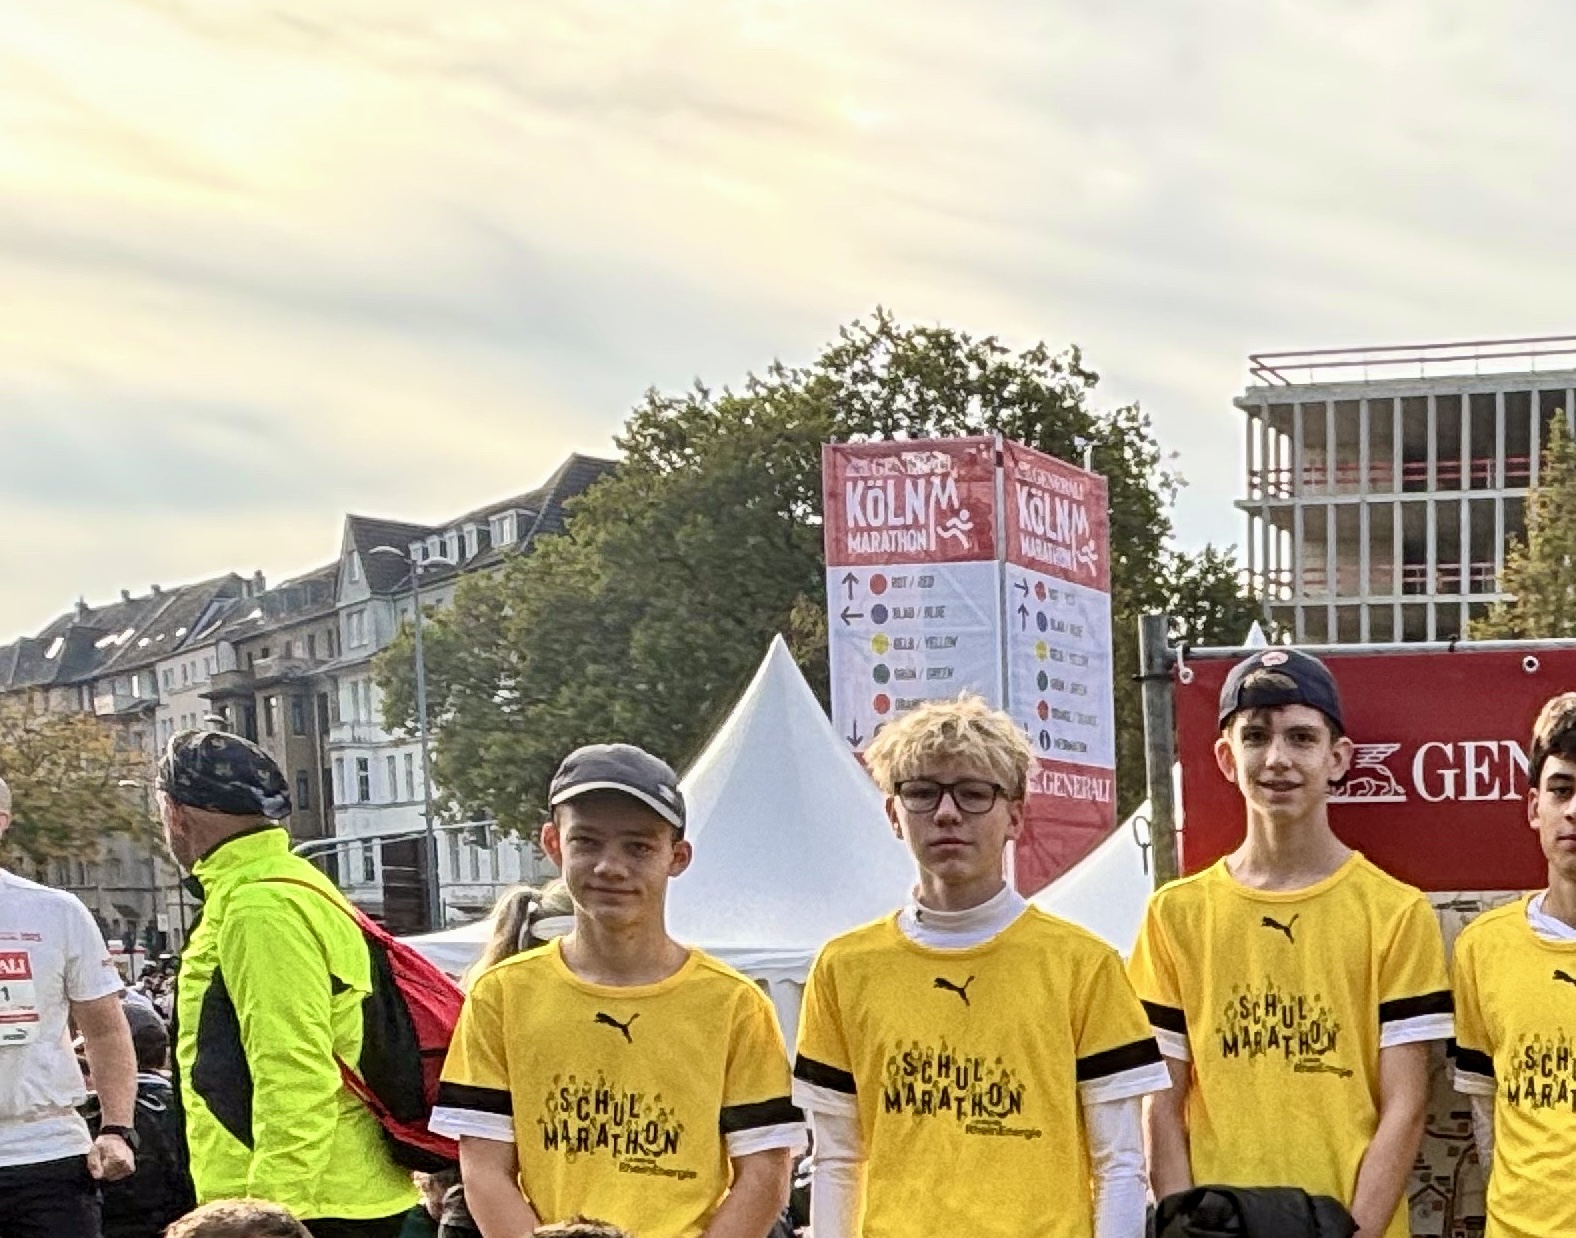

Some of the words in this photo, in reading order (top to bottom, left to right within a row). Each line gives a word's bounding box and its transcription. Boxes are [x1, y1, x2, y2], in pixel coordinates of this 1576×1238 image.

[846, 478, 926, 528] KÖLN
[1015, 482, 1071, 545] KÖLN
[848, 528, 927, 554] MARATHON
[1043, 771, 1111, 803] GENERALI
[1239, 994, 1307, 1029] SCHUL
[1223, 1020, 1337, 1060] MARATHON
[902, 1052, 984, 1091] SCHUL
[559, 1087, 640, 1127] SCHUL
[884, 1082, 1022, 1121] MARATHON
[543, 1119, 680, 1157] MARATHON
